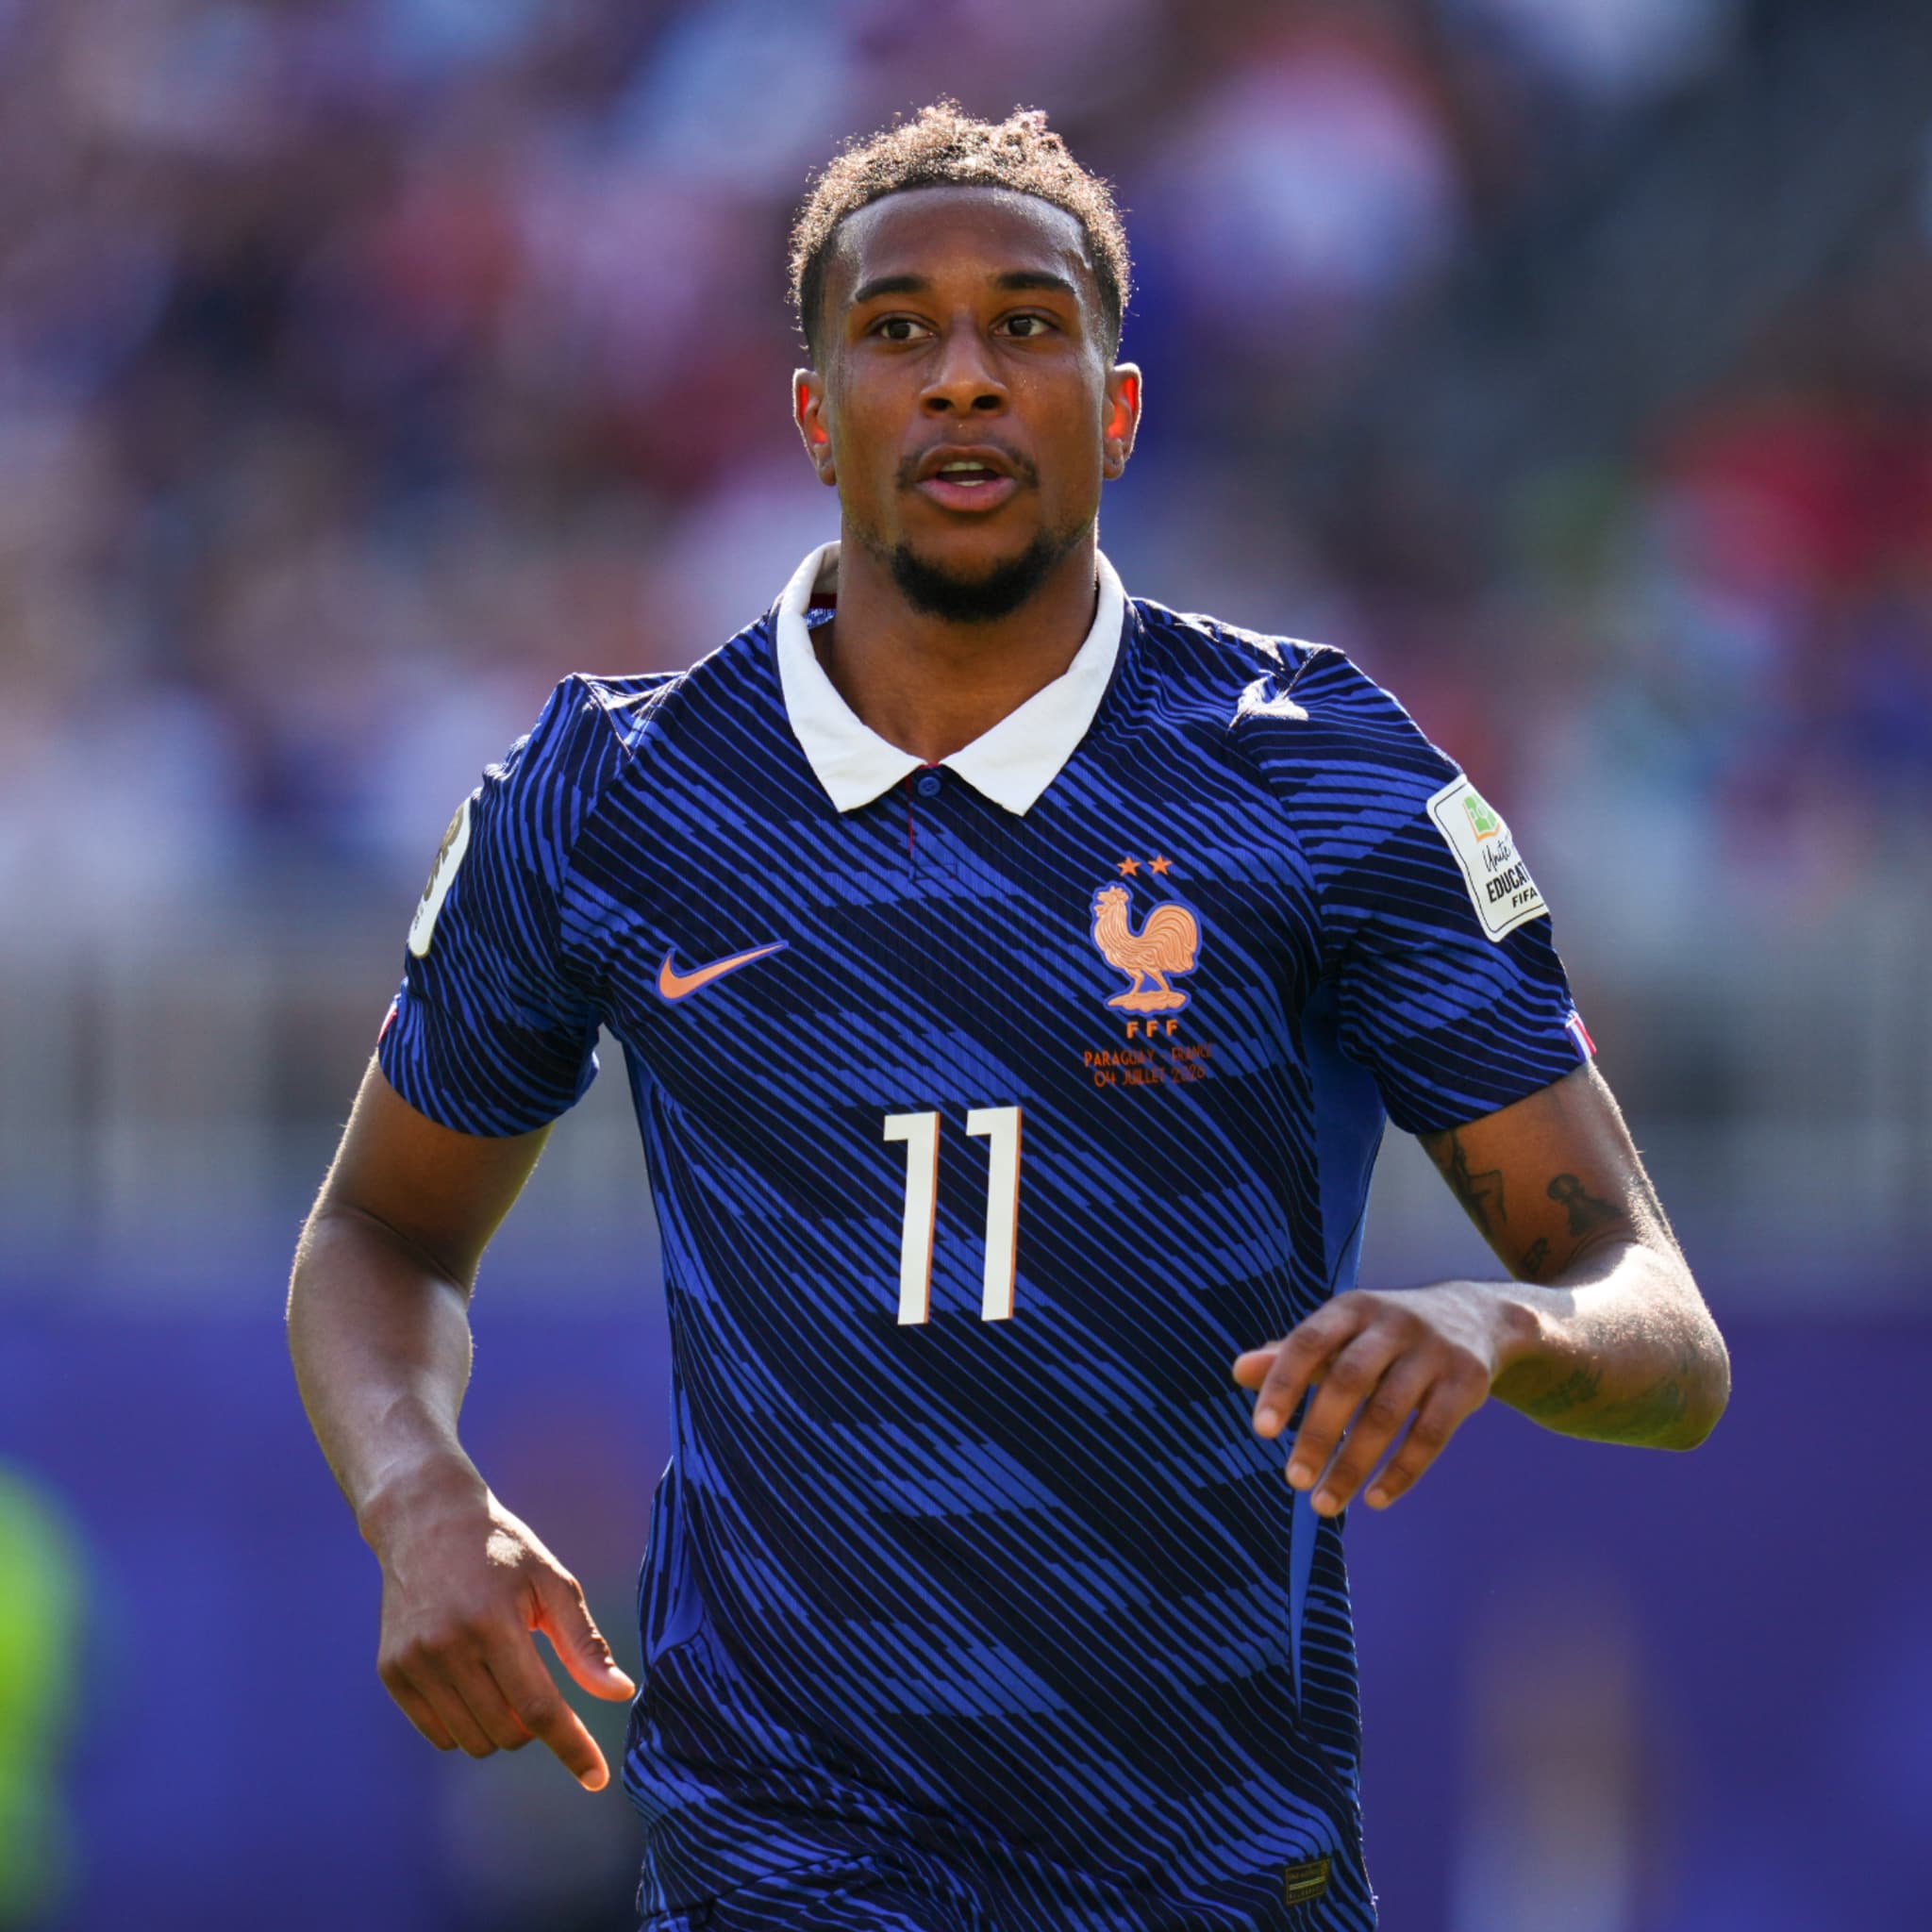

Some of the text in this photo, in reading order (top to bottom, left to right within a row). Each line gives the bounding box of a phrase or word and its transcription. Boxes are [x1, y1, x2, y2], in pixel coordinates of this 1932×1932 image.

[1512, 887, 1538, 908] FIFA
[1084, 1048, 1155, 1067] PARAGUAY
[1171, 1042, 1213, 1061] FRANCE
[1094, 1070, 1116, 1087] 04
[1123, 1067, 1166, 1085] JUILLET
[883, 1106, 1022, 1325] 11
